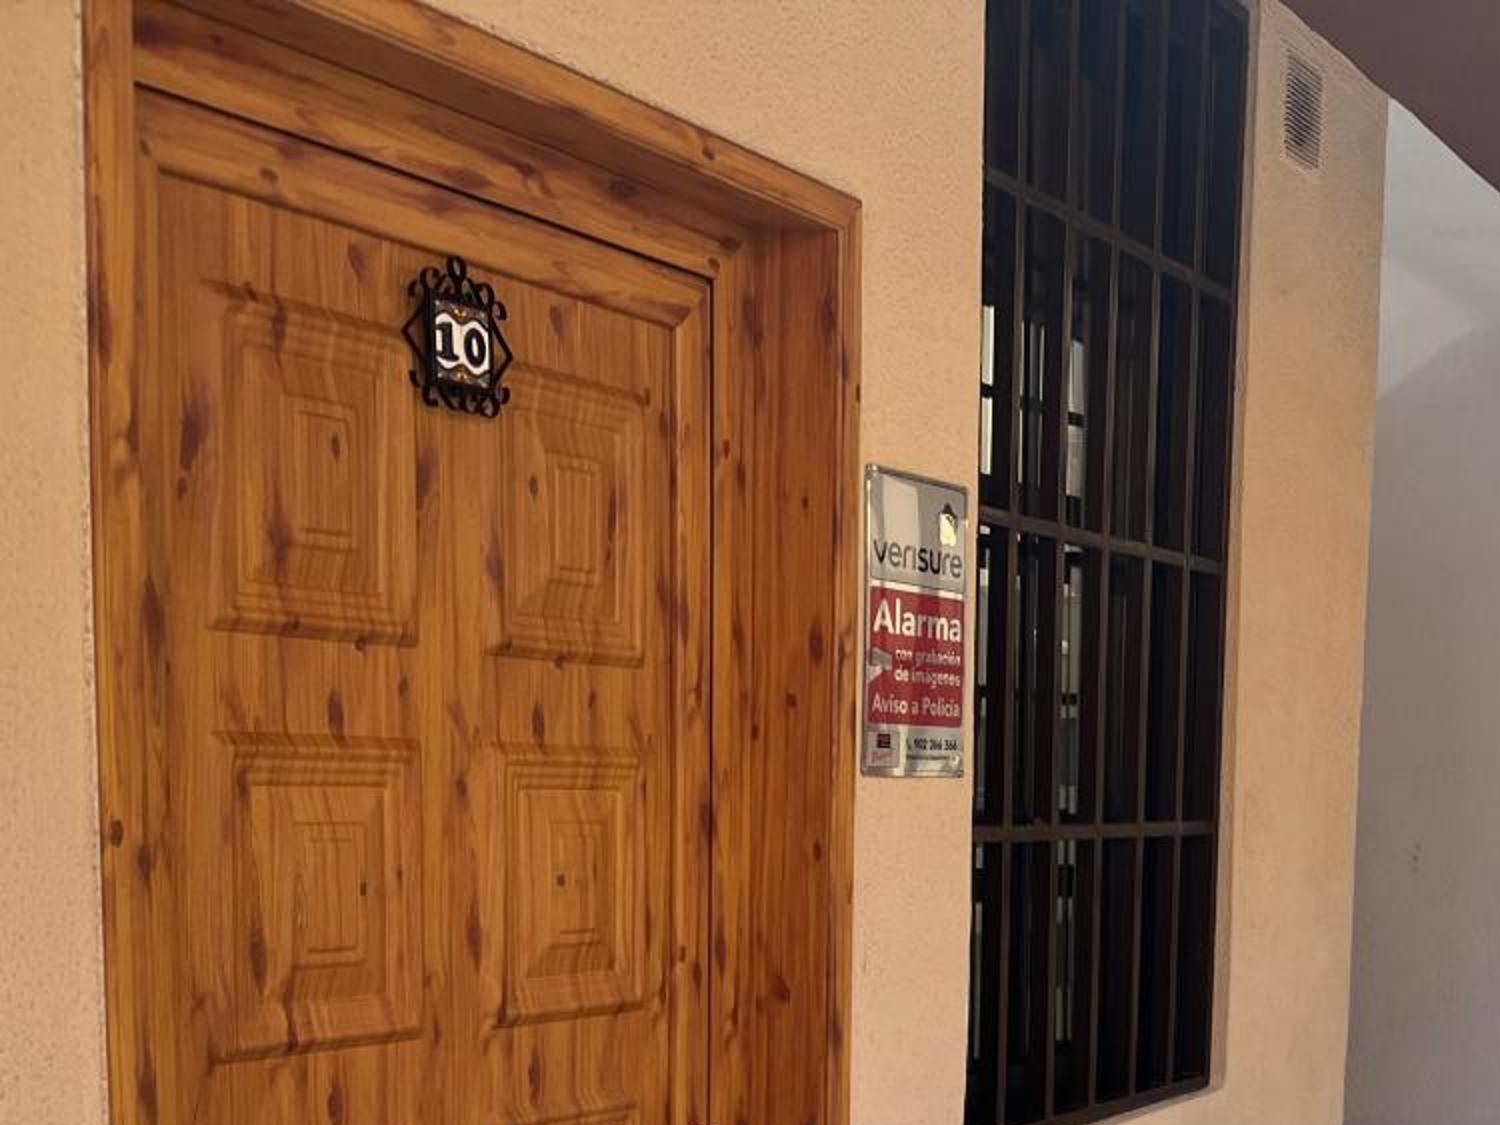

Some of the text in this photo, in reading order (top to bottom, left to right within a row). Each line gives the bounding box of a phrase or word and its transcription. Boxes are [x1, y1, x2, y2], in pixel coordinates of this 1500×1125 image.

[436, 321, 487, 369] 10
[873, 538, 962, 579] verisure
[873, 598, 961, 642] Alarma
[894, 664, 909, 682] de
[871, 691, 909, 715] Aviso
[911, 700, 919, 716] a
